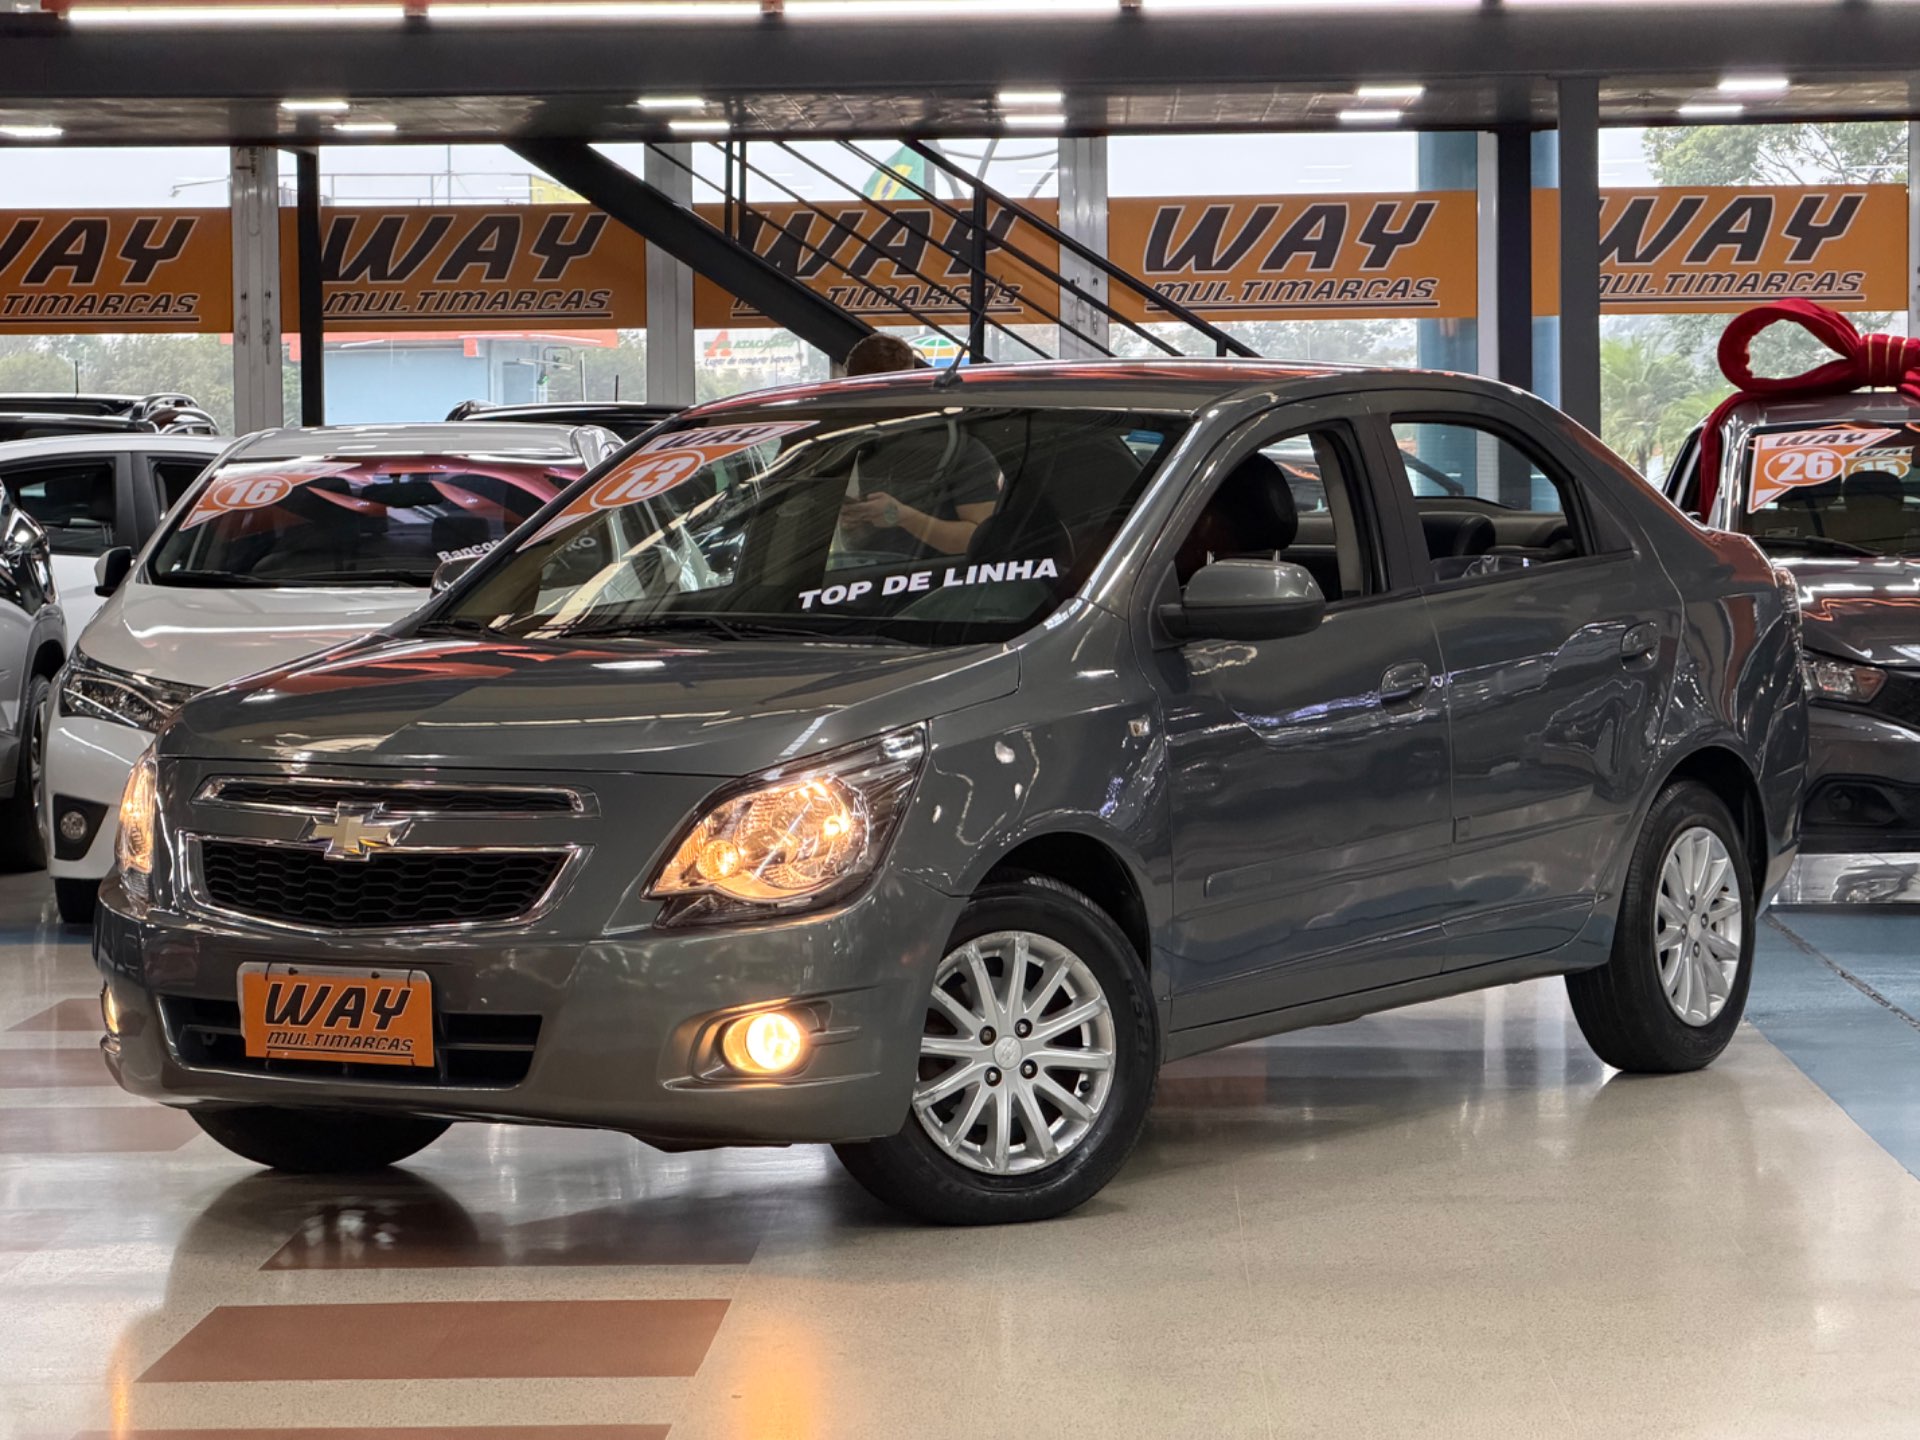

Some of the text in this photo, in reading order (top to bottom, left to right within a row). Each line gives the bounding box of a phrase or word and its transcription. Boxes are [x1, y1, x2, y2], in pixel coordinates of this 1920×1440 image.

[736, 207, 1017, 281] WAY
[1144, 200, 1440, 275] WAY
[1599, 193, 1867, 267] WAY
[322, 212, 610, 285] WAY
[323, 289, 612, 315] MULTIMARCAS
[731, 284, 1023, 311] TIMARCAS
[1145, 278, 1440, 305] MULTIMARCAS
[656, 426, 775, 450] WAY
[1775, 433, 1868, 447] WAY
[602, 456, 695, 501] 13
[1777, 452, 1834, 481] 26
[226, 479, 283, 505] 16
[798, 558, 1058, 609] TOP DE LINHA
[264, 981, 413, 1031] WAY
[266, 1031, 414, 1052] MULTIMARCAS
